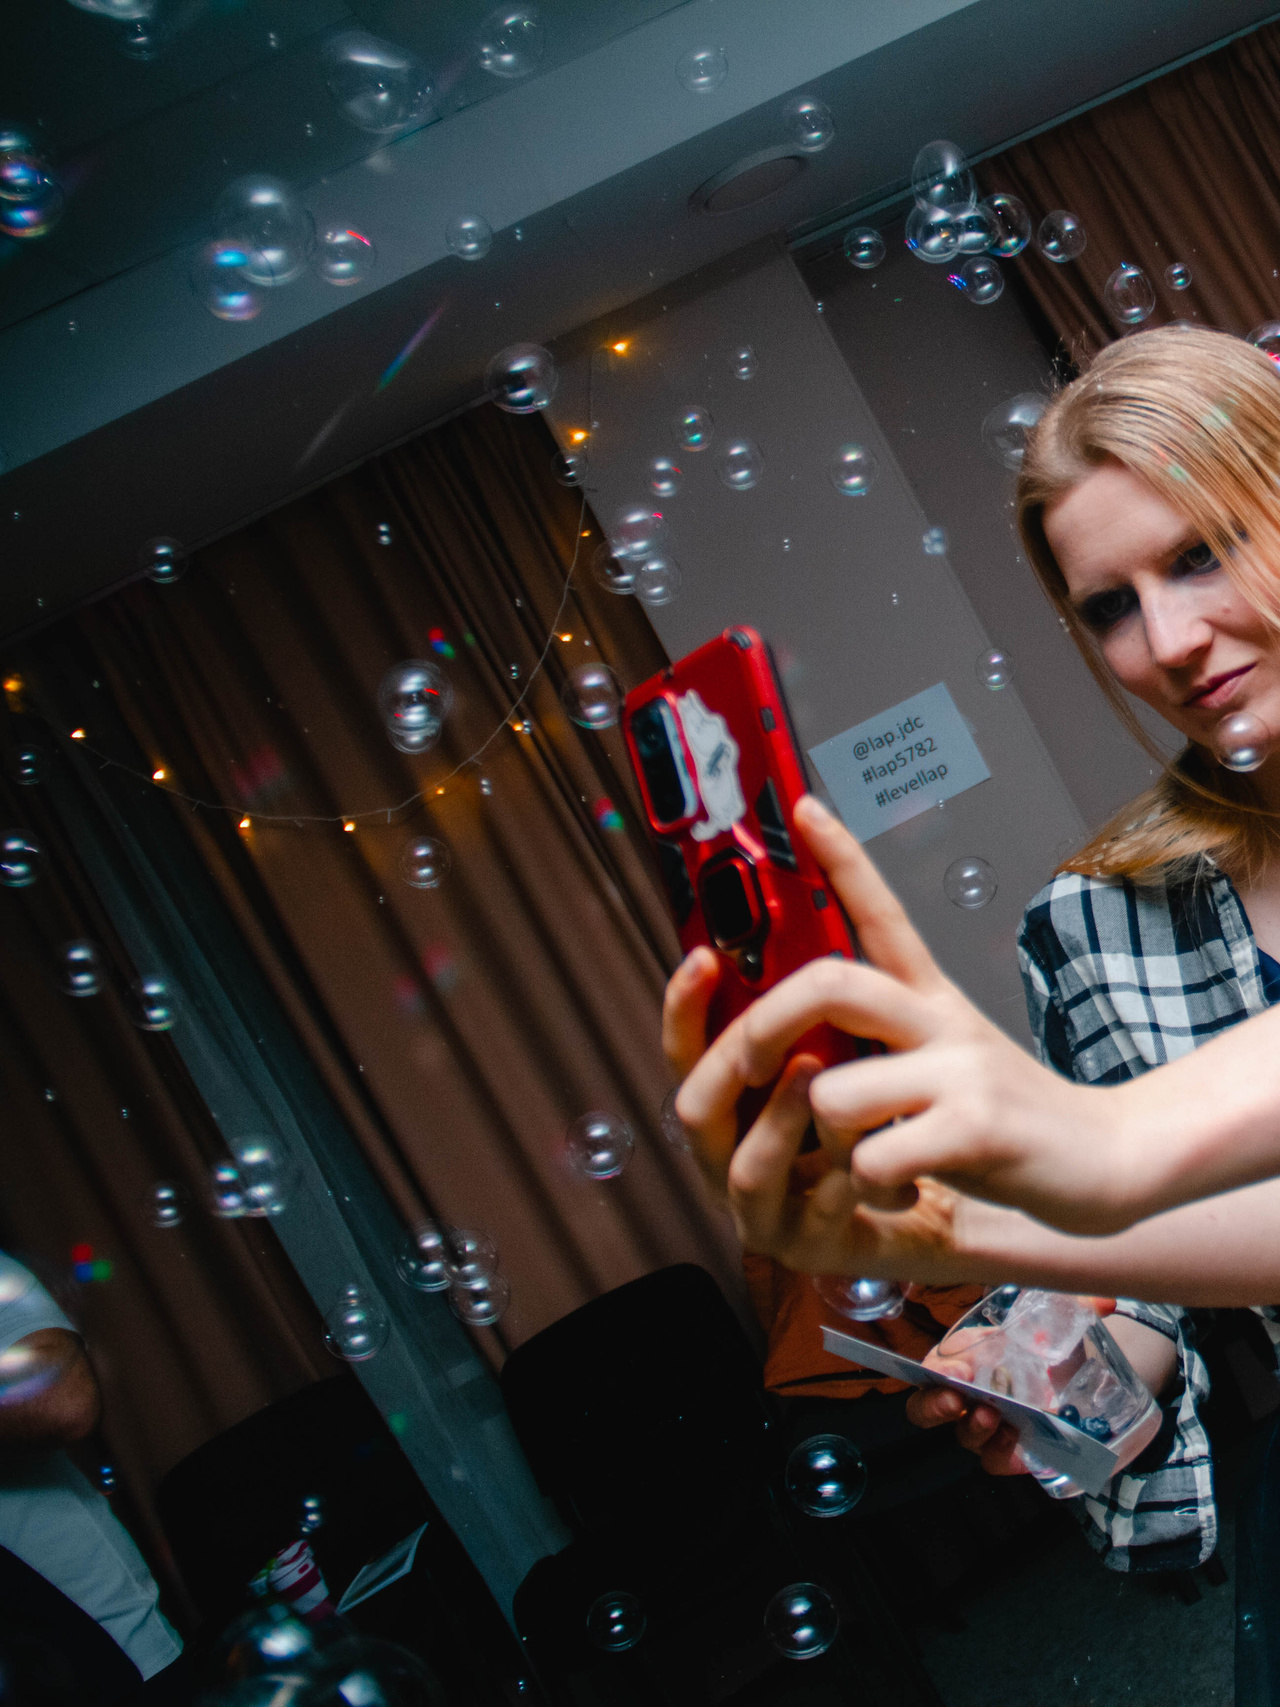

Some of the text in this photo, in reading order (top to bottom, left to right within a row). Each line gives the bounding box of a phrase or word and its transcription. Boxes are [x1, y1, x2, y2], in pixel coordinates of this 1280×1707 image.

[853, 716, 924, 761] @lap.jdc
[862, 737, 937, 786] #lap5782
[875, 764, 948, 808] #levellap
